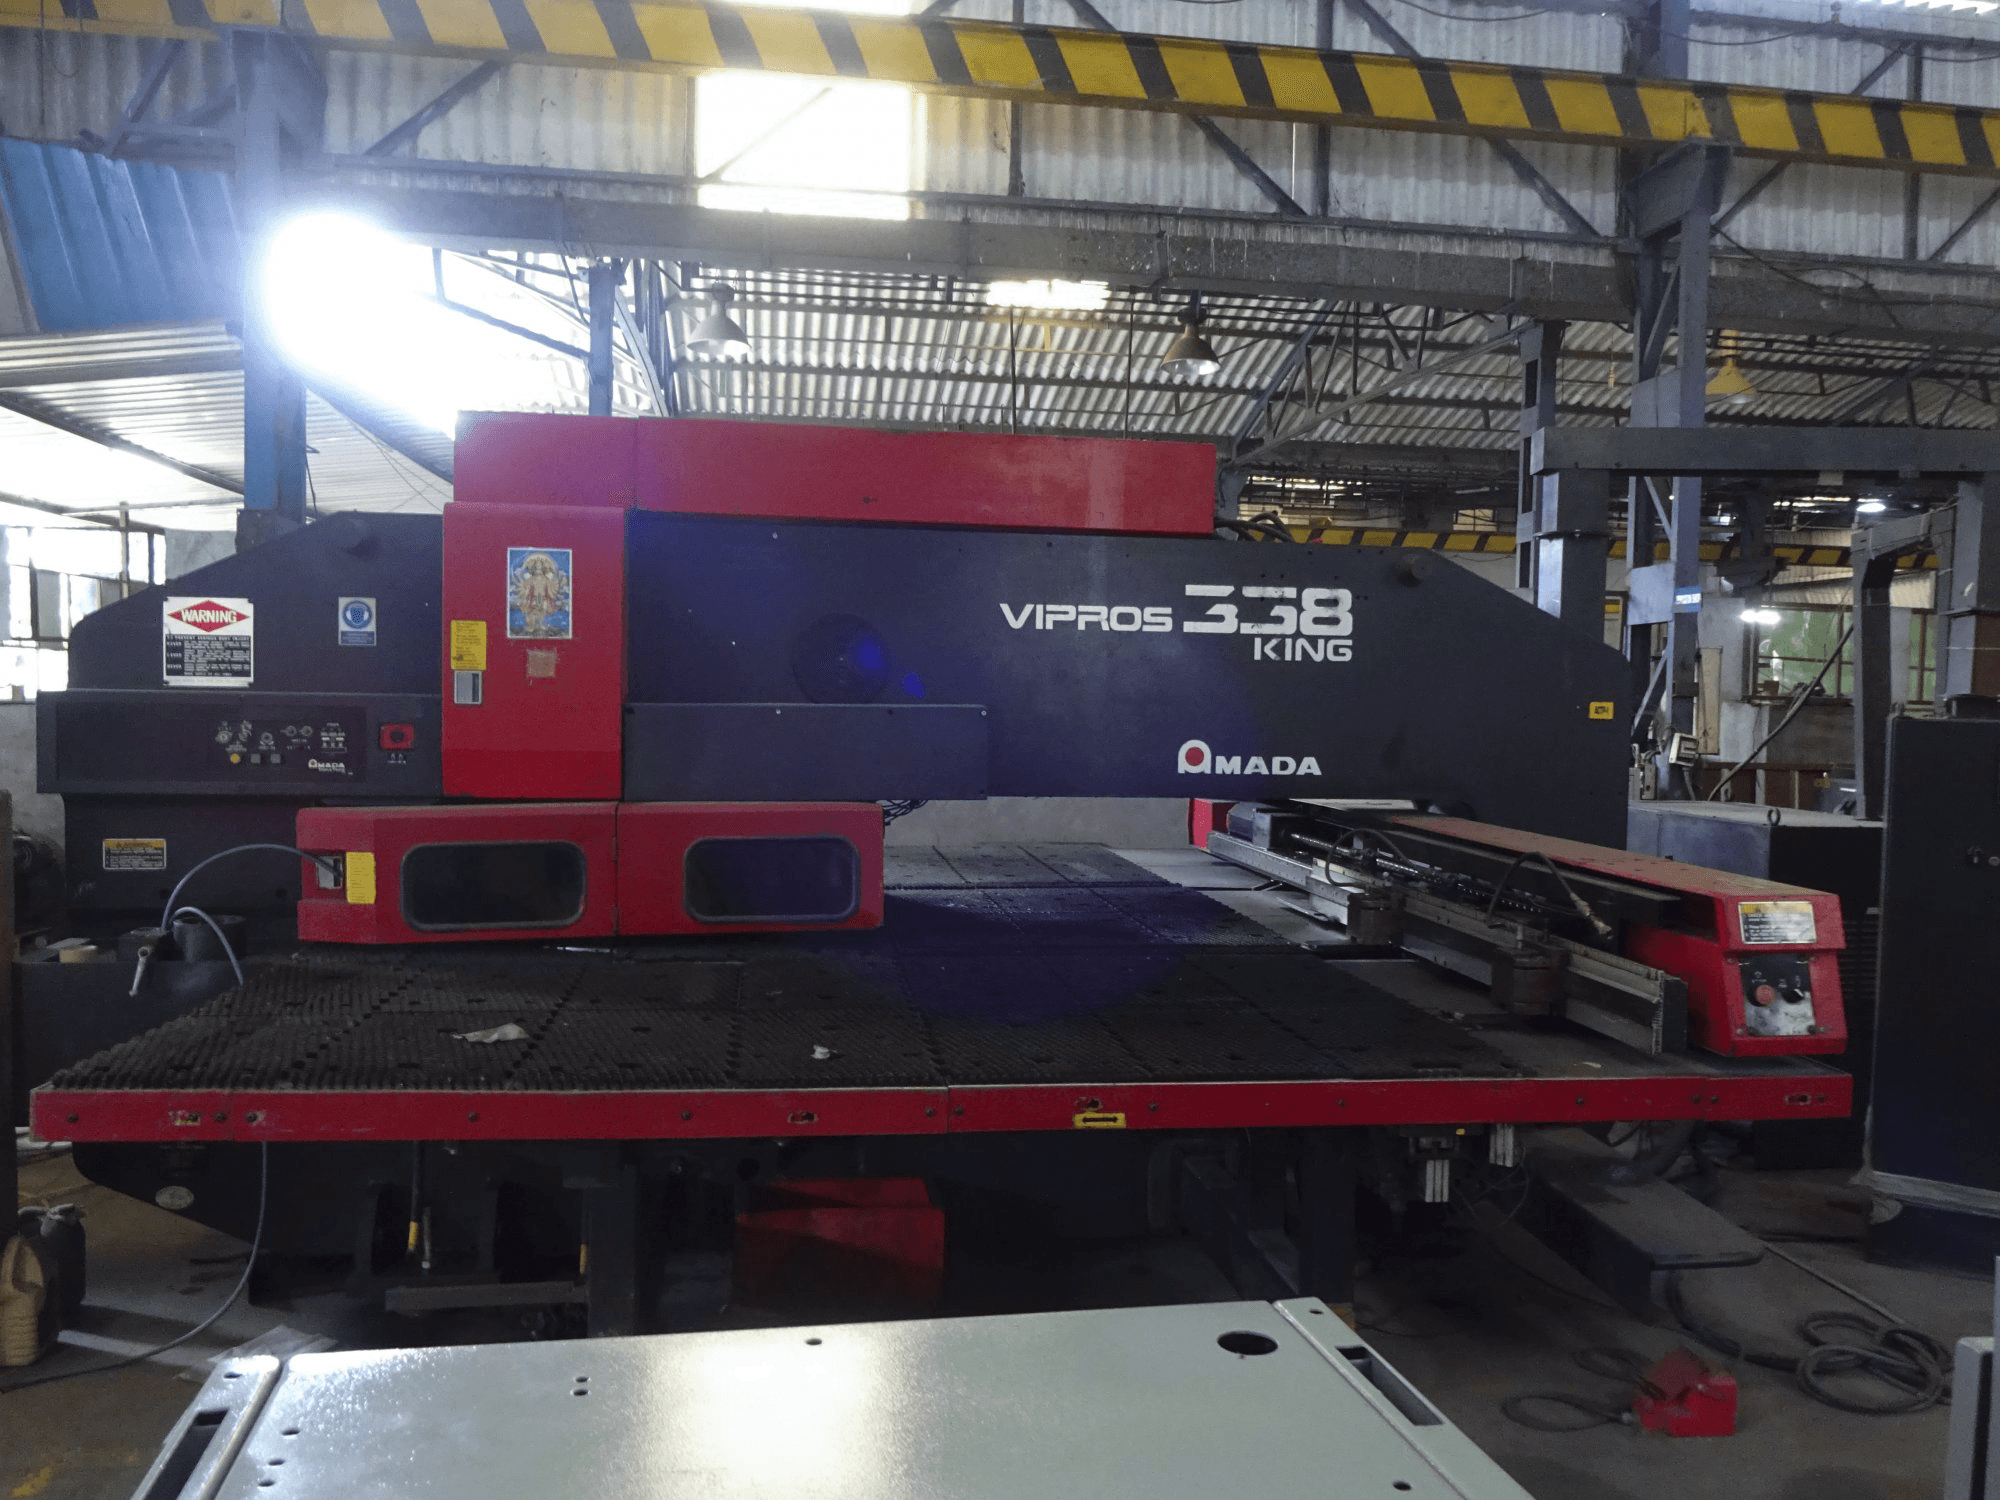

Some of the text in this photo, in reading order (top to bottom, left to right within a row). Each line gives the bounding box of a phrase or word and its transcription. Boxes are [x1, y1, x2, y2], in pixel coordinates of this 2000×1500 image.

[181, 609, 237, 623] WARNING
[1000, 584, 1354, 637] VIPROS 338
[1253, 637, 1353, 662] KING
[1177, 739, 1323, 776] AMADA
